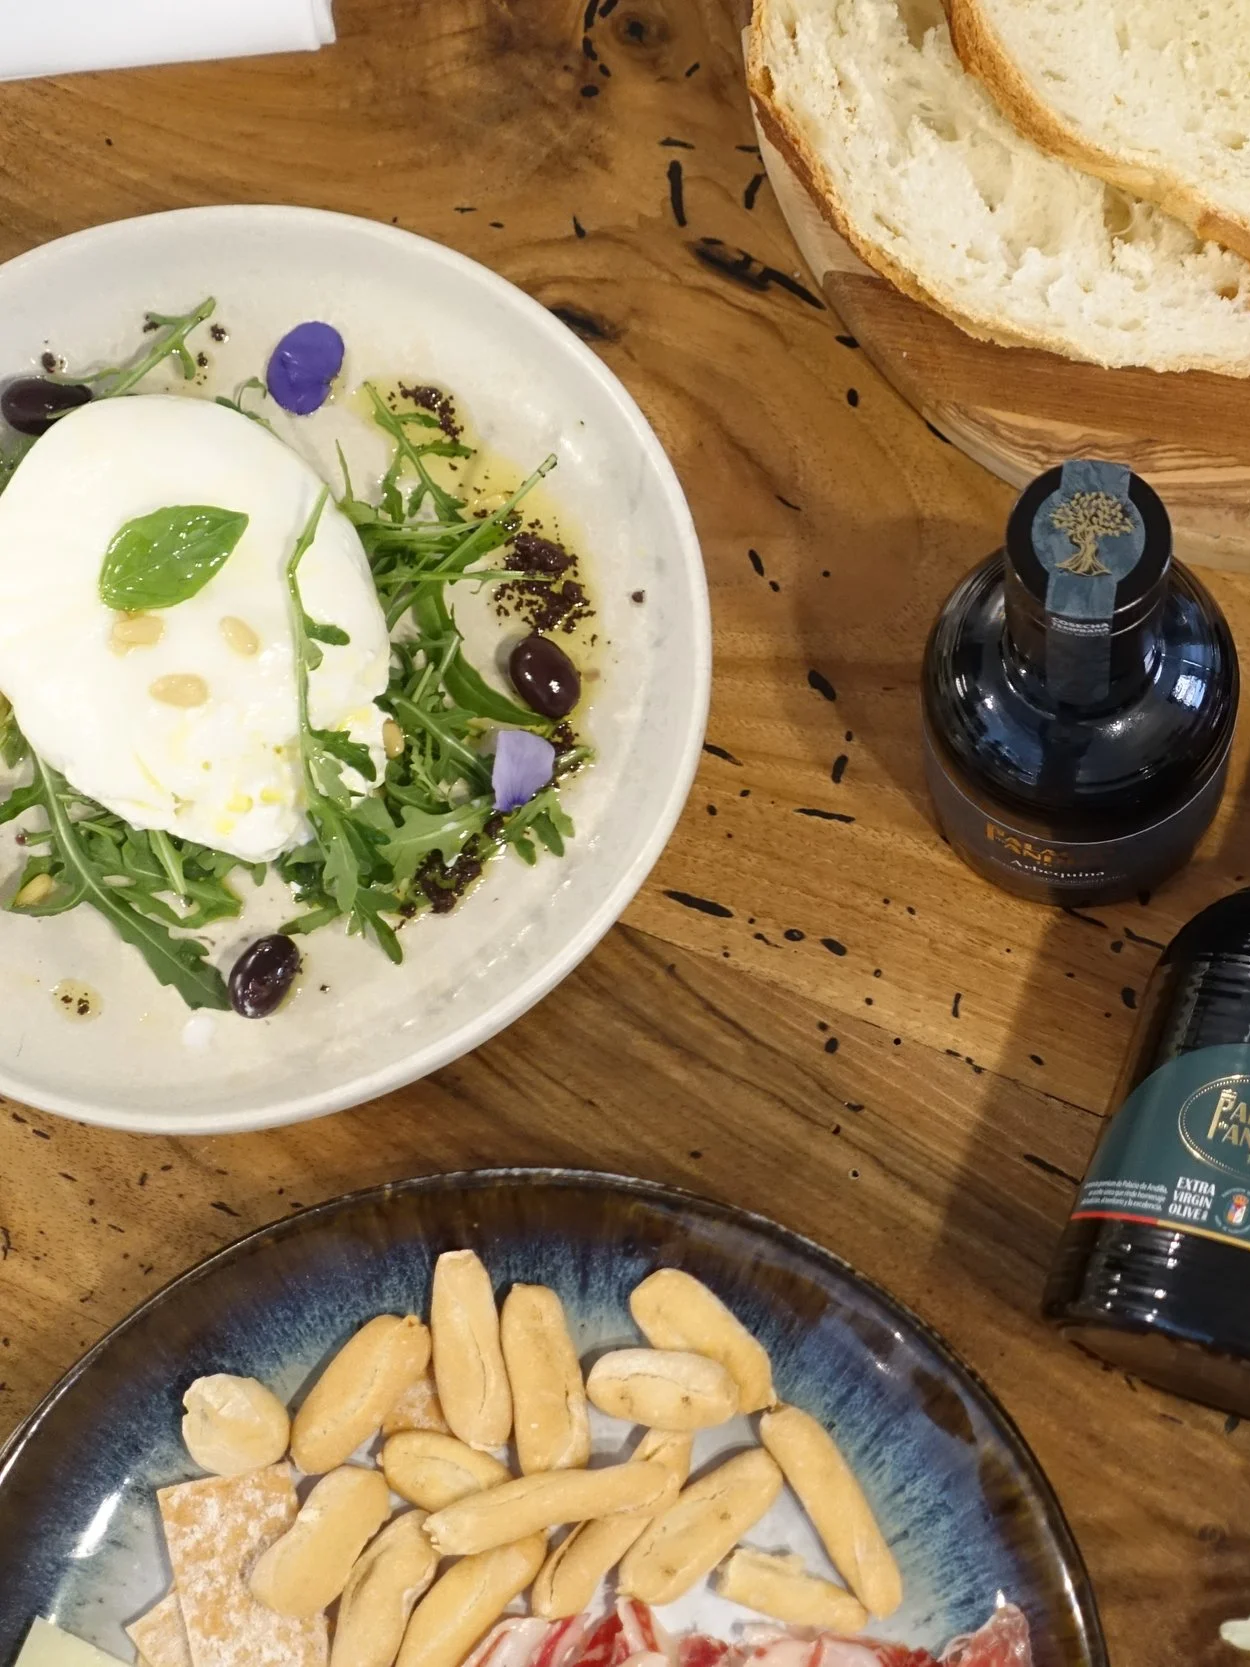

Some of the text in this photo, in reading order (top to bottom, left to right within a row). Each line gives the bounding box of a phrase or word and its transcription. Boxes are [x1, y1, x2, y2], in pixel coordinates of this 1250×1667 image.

[1176, 1176, 1216, 1197] EXTRA
[1173, 1190, 1213, 1209] VIRGIN
[1168, 1203, 1201, 1221] OLIVE
